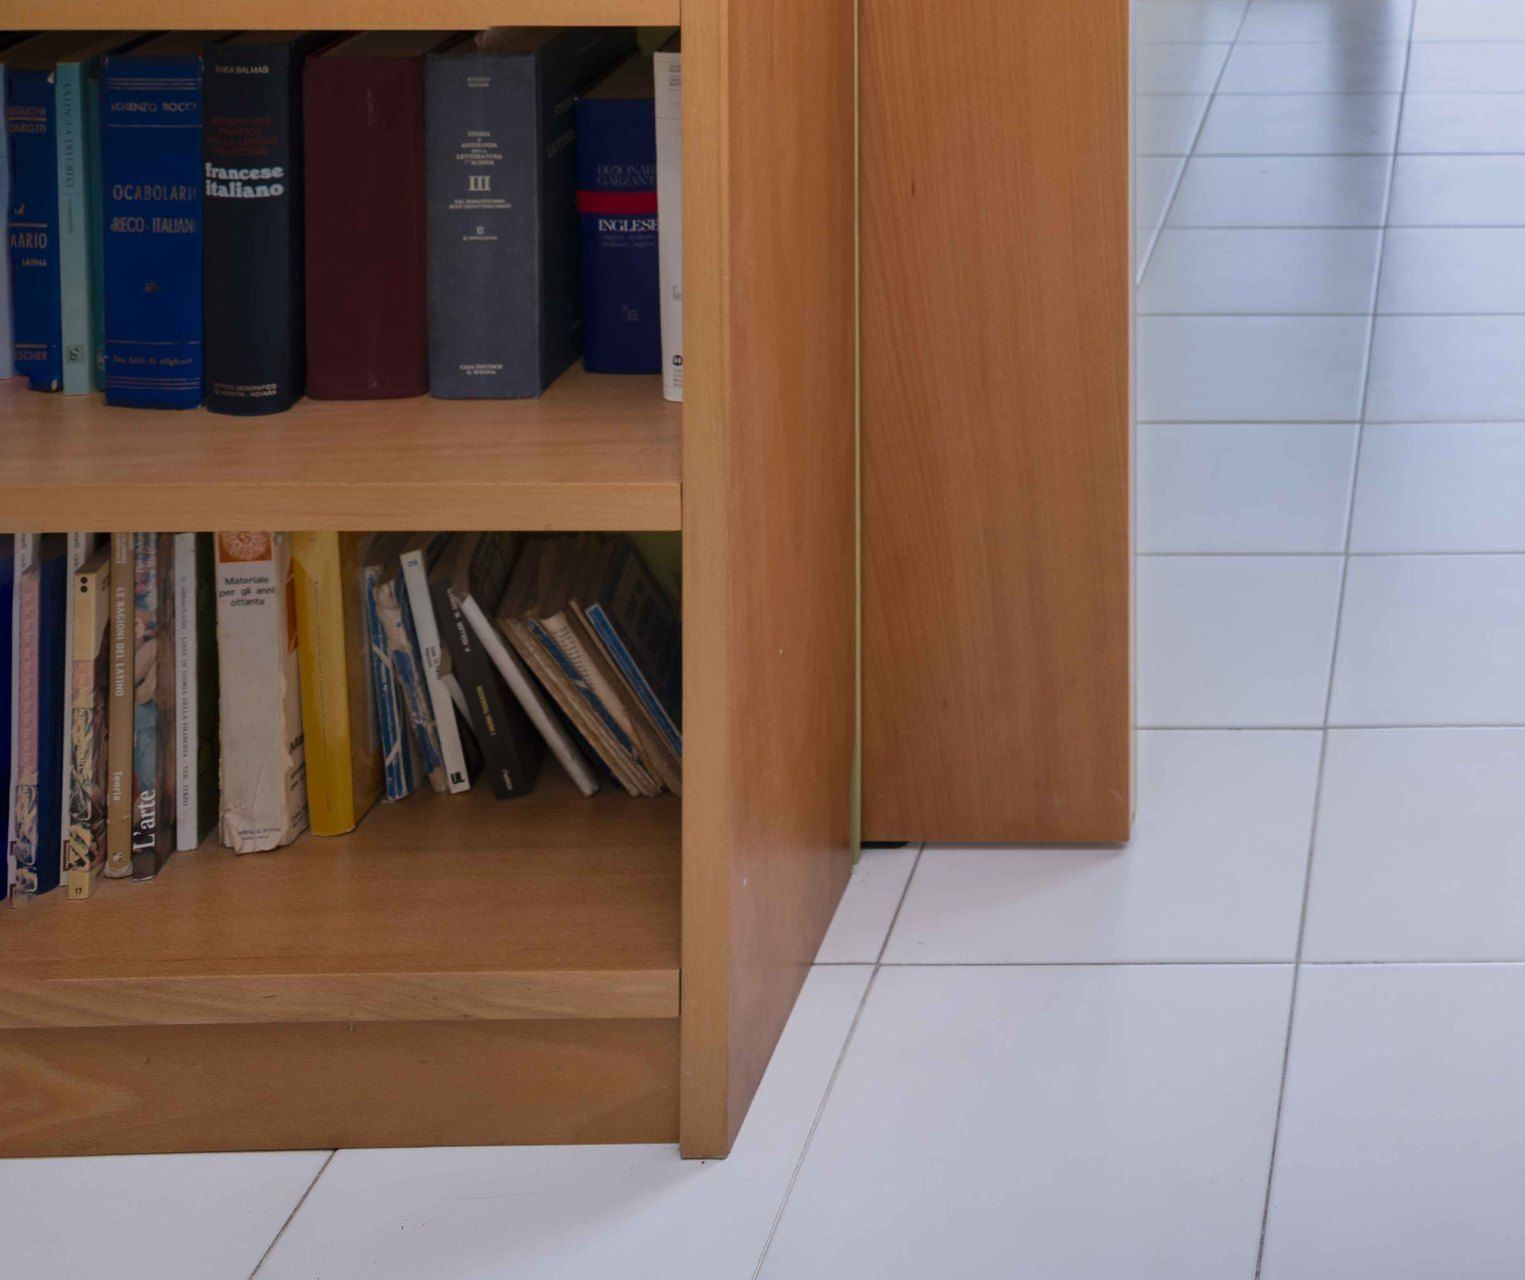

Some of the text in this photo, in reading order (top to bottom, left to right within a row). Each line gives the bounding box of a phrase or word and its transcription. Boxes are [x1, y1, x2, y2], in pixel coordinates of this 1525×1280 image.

[204, 162, 284, 181] francese
[205, 181, 285, 199] italiano
[224, 577, 269, 586] Materiale
[219, 588, 237, 600] per
[241, 587, 255, 599] gli
[230, 596, 265, 608] ottanta
[115, 586, 125, 698] LE RAGIONI DEL LATINO
[133, 789, 156, 853] L'arte
